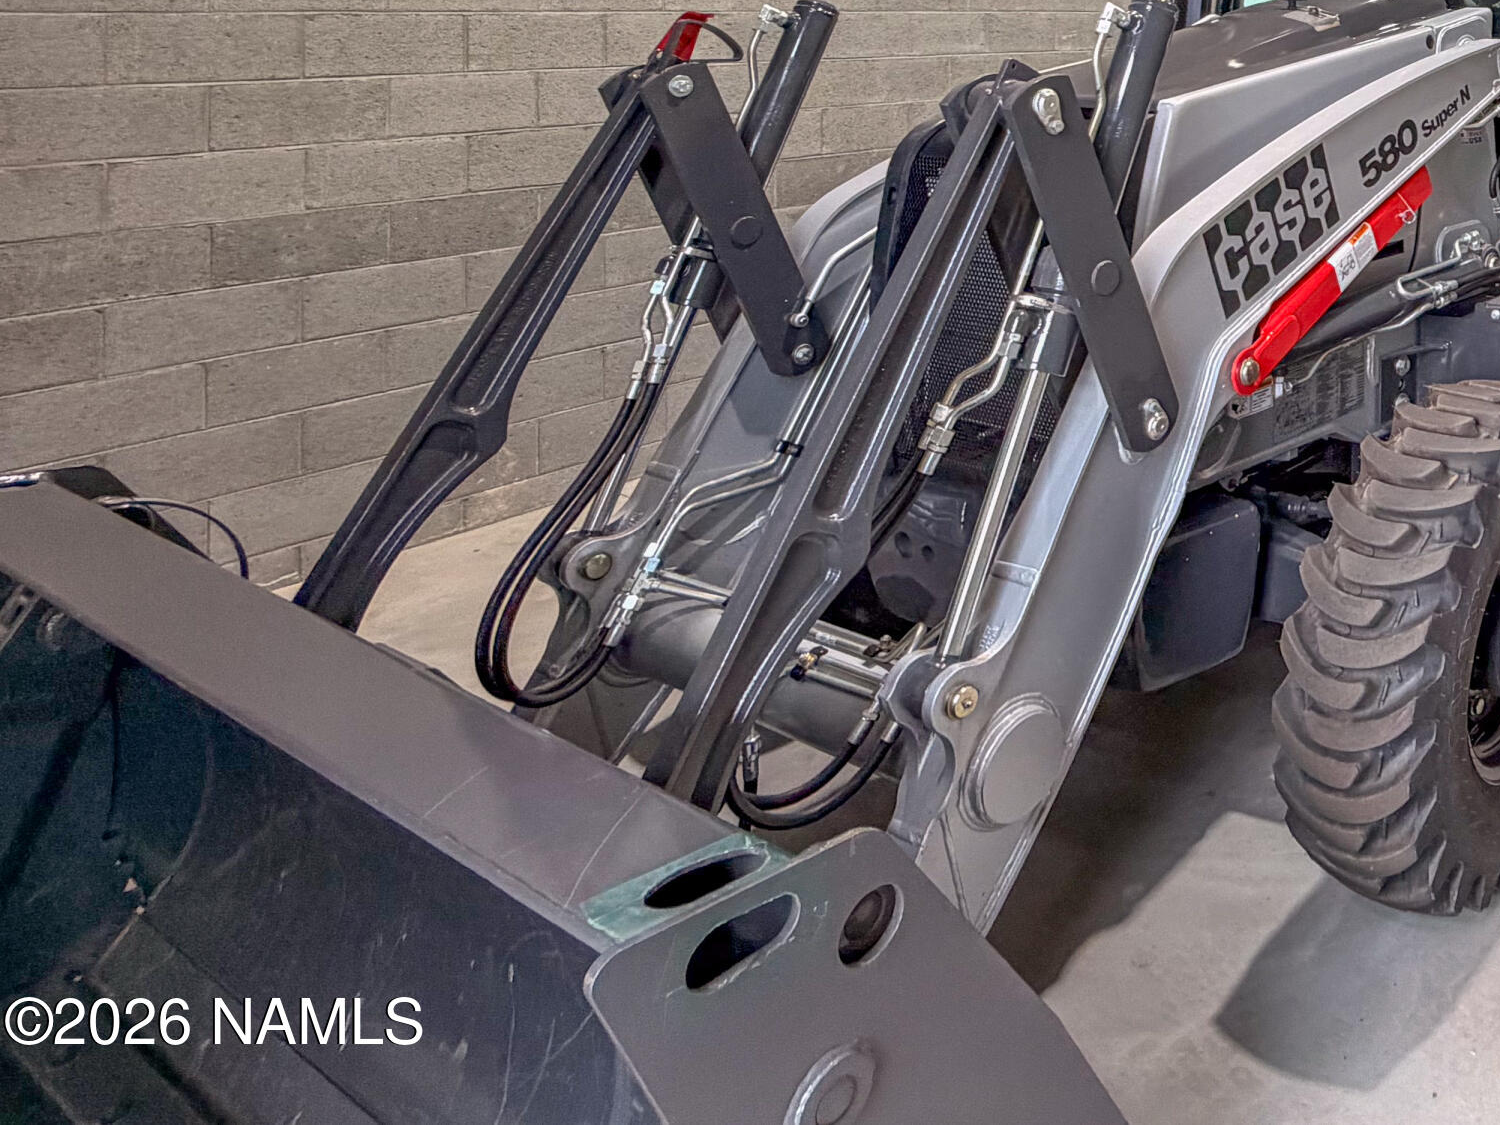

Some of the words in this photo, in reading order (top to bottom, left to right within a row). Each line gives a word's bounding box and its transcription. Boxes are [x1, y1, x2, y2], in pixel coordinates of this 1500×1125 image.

[1358, 118, 1418, 188] 580
[1421, 97, 1459, 138] Super
[1459, 84, 1471, 105] N
